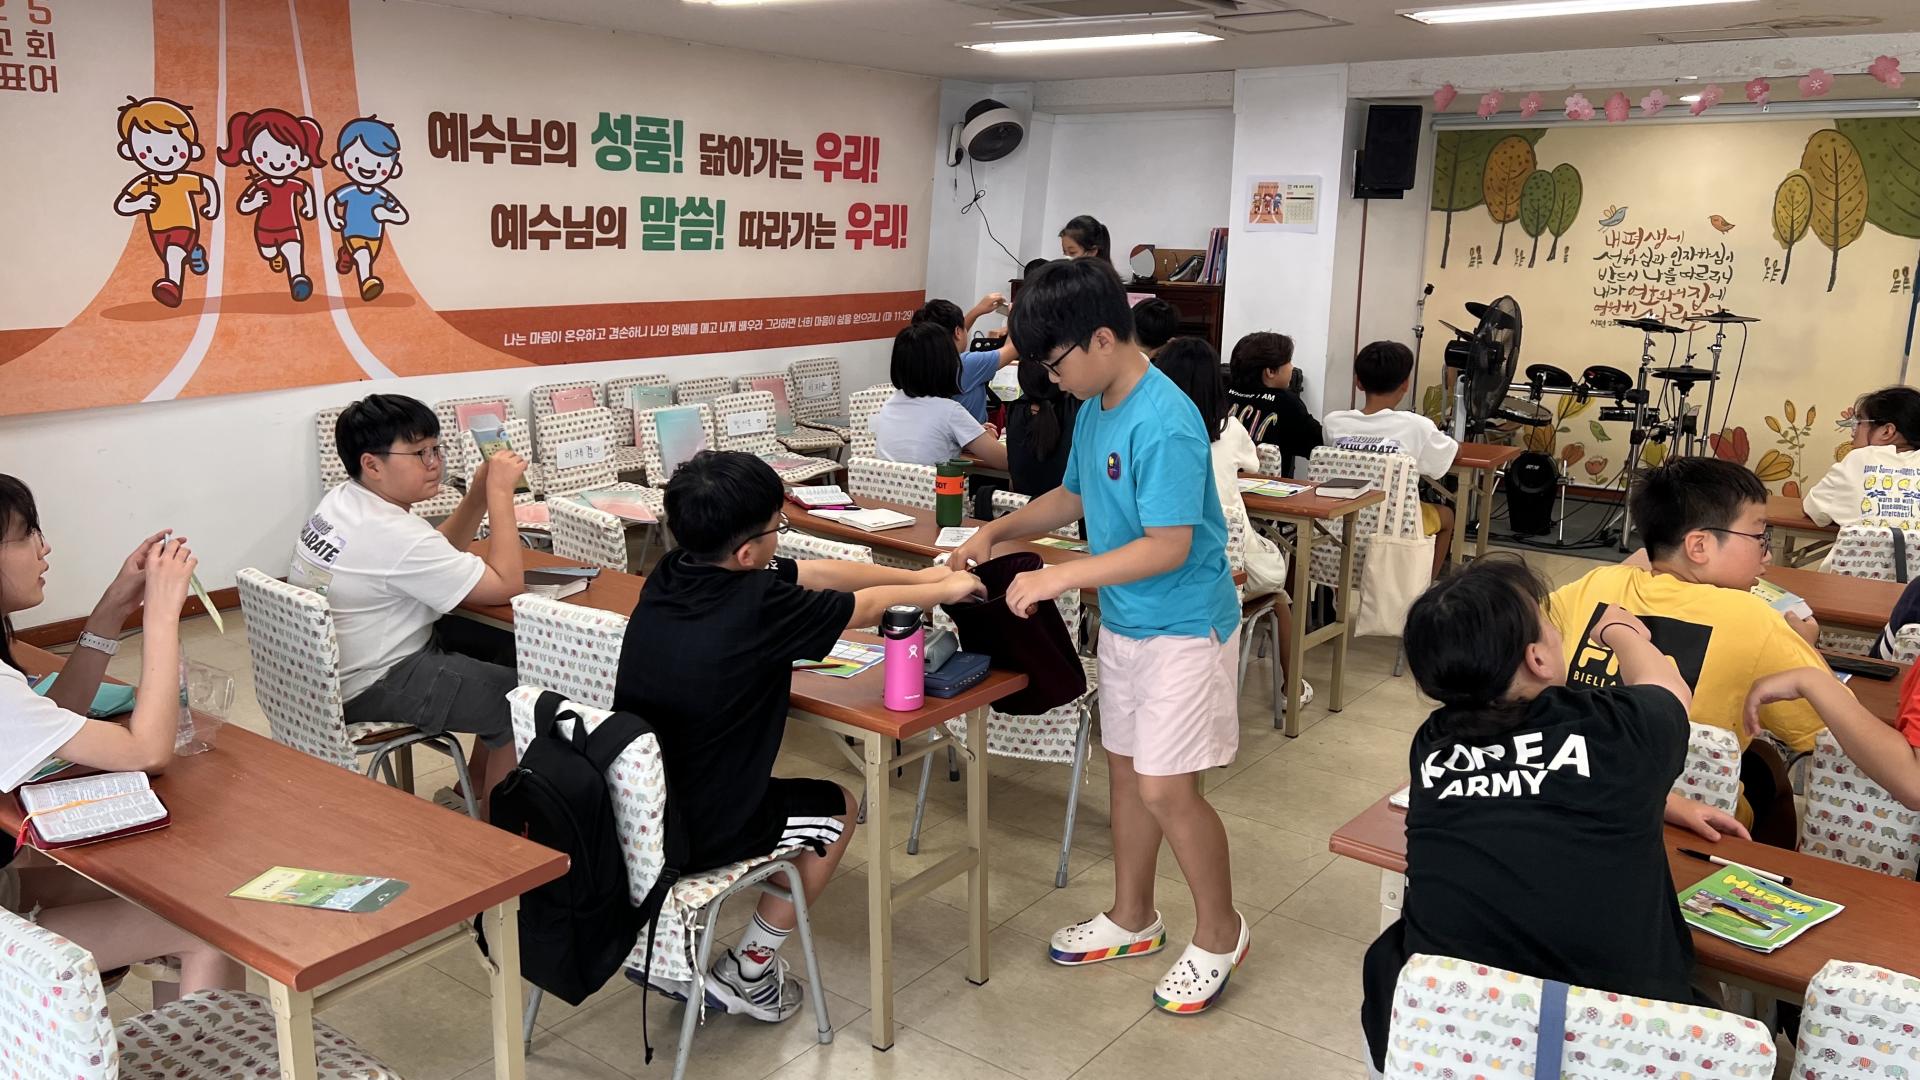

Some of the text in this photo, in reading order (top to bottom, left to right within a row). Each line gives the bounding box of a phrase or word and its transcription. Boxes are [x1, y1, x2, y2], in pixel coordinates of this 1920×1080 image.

[428, 111, 880, 184] 예수님의 성품! 닮아가는 우리!
[490, 195, 909, 251] 예수님의 말씀! 따라가는 우리!
[1593, 242, 1735, 268] 선하심과 인자하심이
[1606, 227, 1685, 256] 내 평생에
[1598, 264, 1735, 286] 반드시 나를 따르리니
[1593, 282, 1727, 310] 내가 여호와의 집에
[1593, 299, 1638, 317] 영원히
[504, 333, 527, 347] 나는
[529, 330, 562, 345] 마음이
[564, 328, 606, 343] 온유하고
[608, 325, 649, 340] 겸손하니
[650, 324, 669, 337] 나의
[671, 322, 699, 335] 멍에를
[700, 321, 718, 334] 메고
[719, 320, 737, 333] 내게
[738, 319, 763, 332] 배우라
[765, 317, 796, 330] 그리하면
[797, 317, 813, 329] 너희
[814, 314, 837, 327] 마음이
[837, 314, 852, 326] 쉼을
[853, 312, 882, 325] 얻으리니
[1438, 769, 1549, 800] ARMY
